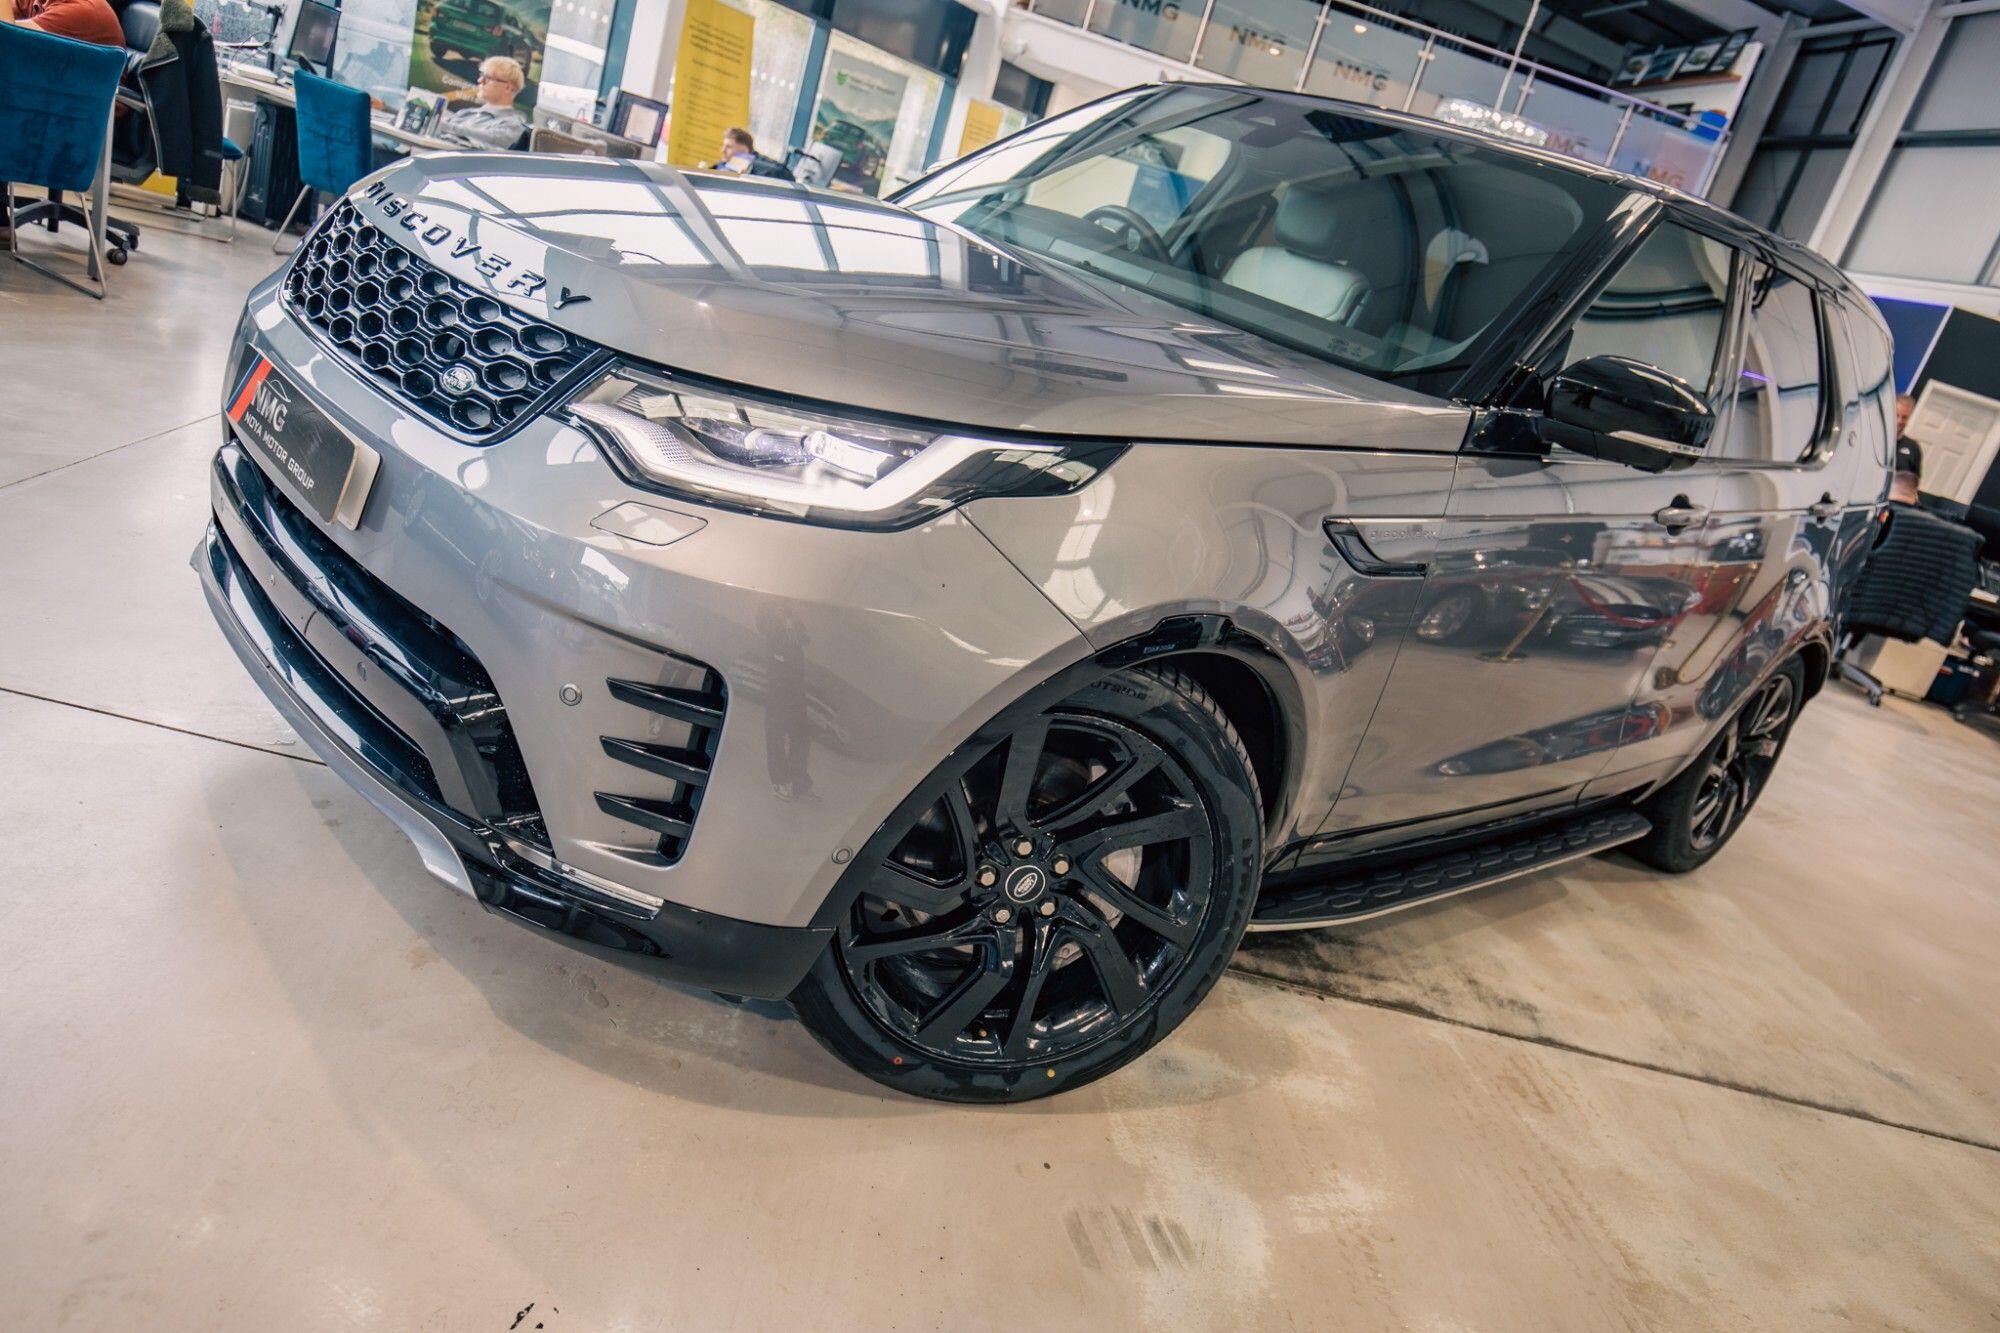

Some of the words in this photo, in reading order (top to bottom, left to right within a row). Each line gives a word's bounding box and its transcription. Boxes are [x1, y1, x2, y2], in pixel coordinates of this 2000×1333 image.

[1229, 25, 1287, 56] NMG
[1332, 60, 1389, 91] NMG
[364, 181, 593, 310] DISCOVERY
[251, 380, 288, 433] NMG
[243, 411, 263, 436] NOYA
[262, 429, 288, 464] MOTOR
[287, 456, 316, 492] GROUP
